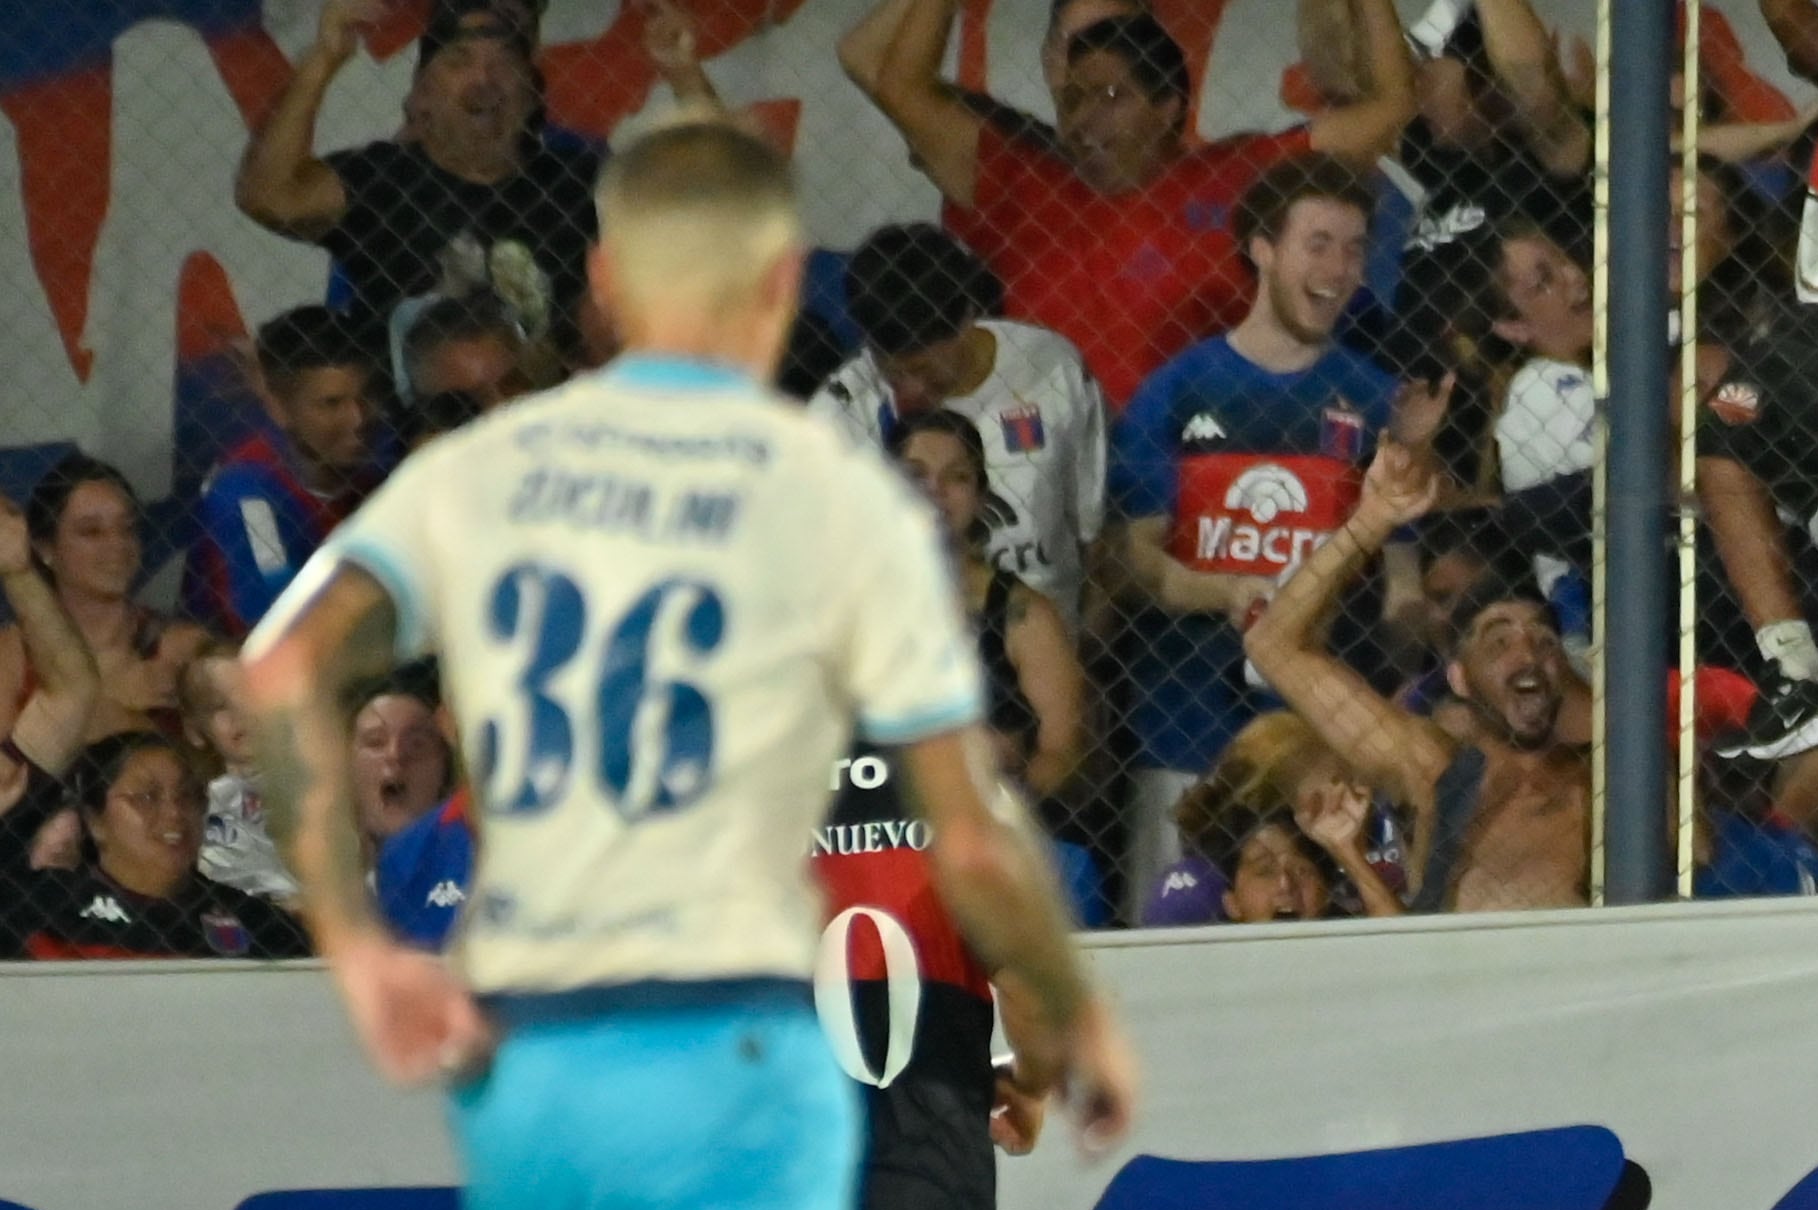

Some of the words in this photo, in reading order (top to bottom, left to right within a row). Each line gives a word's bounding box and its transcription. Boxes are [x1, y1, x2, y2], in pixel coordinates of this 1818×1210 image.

[476, 560, 725, 820] 36
[810, 819, 932, 858] NUEVO
[814, 905, 923, 1090] 0
